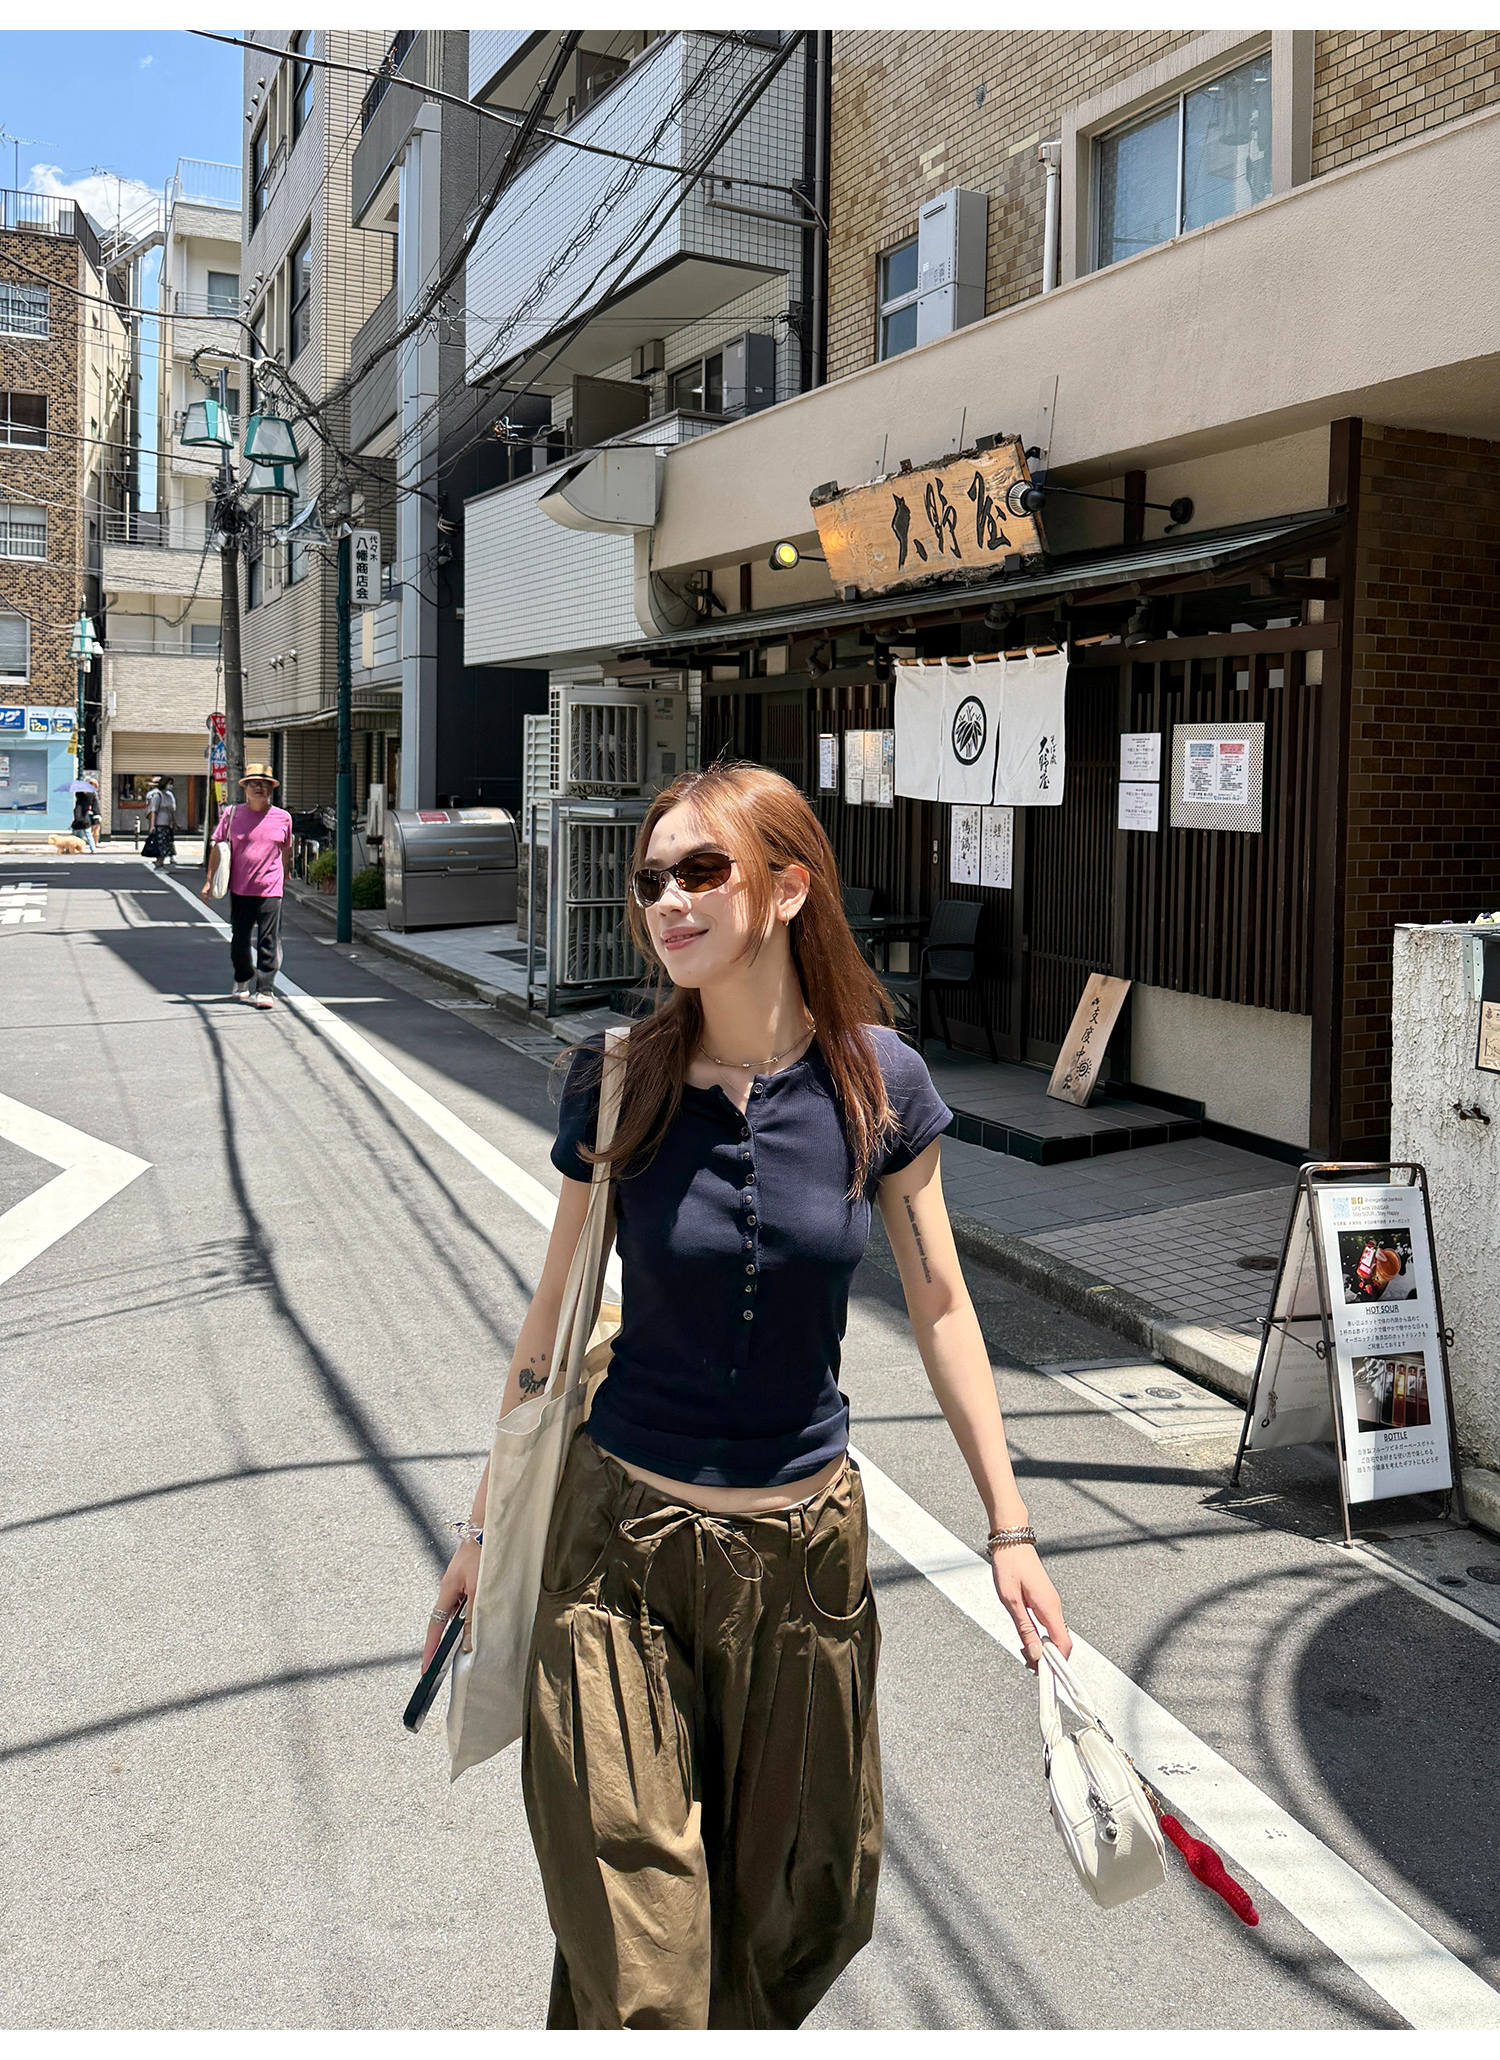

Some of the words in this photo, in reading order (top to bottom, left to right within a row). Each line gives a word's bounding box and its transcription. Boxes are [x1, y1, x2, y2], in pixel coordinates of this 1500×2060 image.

[891, 471, 1011, 571] 大野屋
[369, 535, 378, 562] 代々木
[356, 537, 369, 600] 八幡商店会
[1038, 736, 1050, 789] 大野屋
[912, 1223, 921, 1237] and
[1381, 1305, 1399, 1313] SOUR
[1384, 1431, 1408, 1440] BOTTLE
